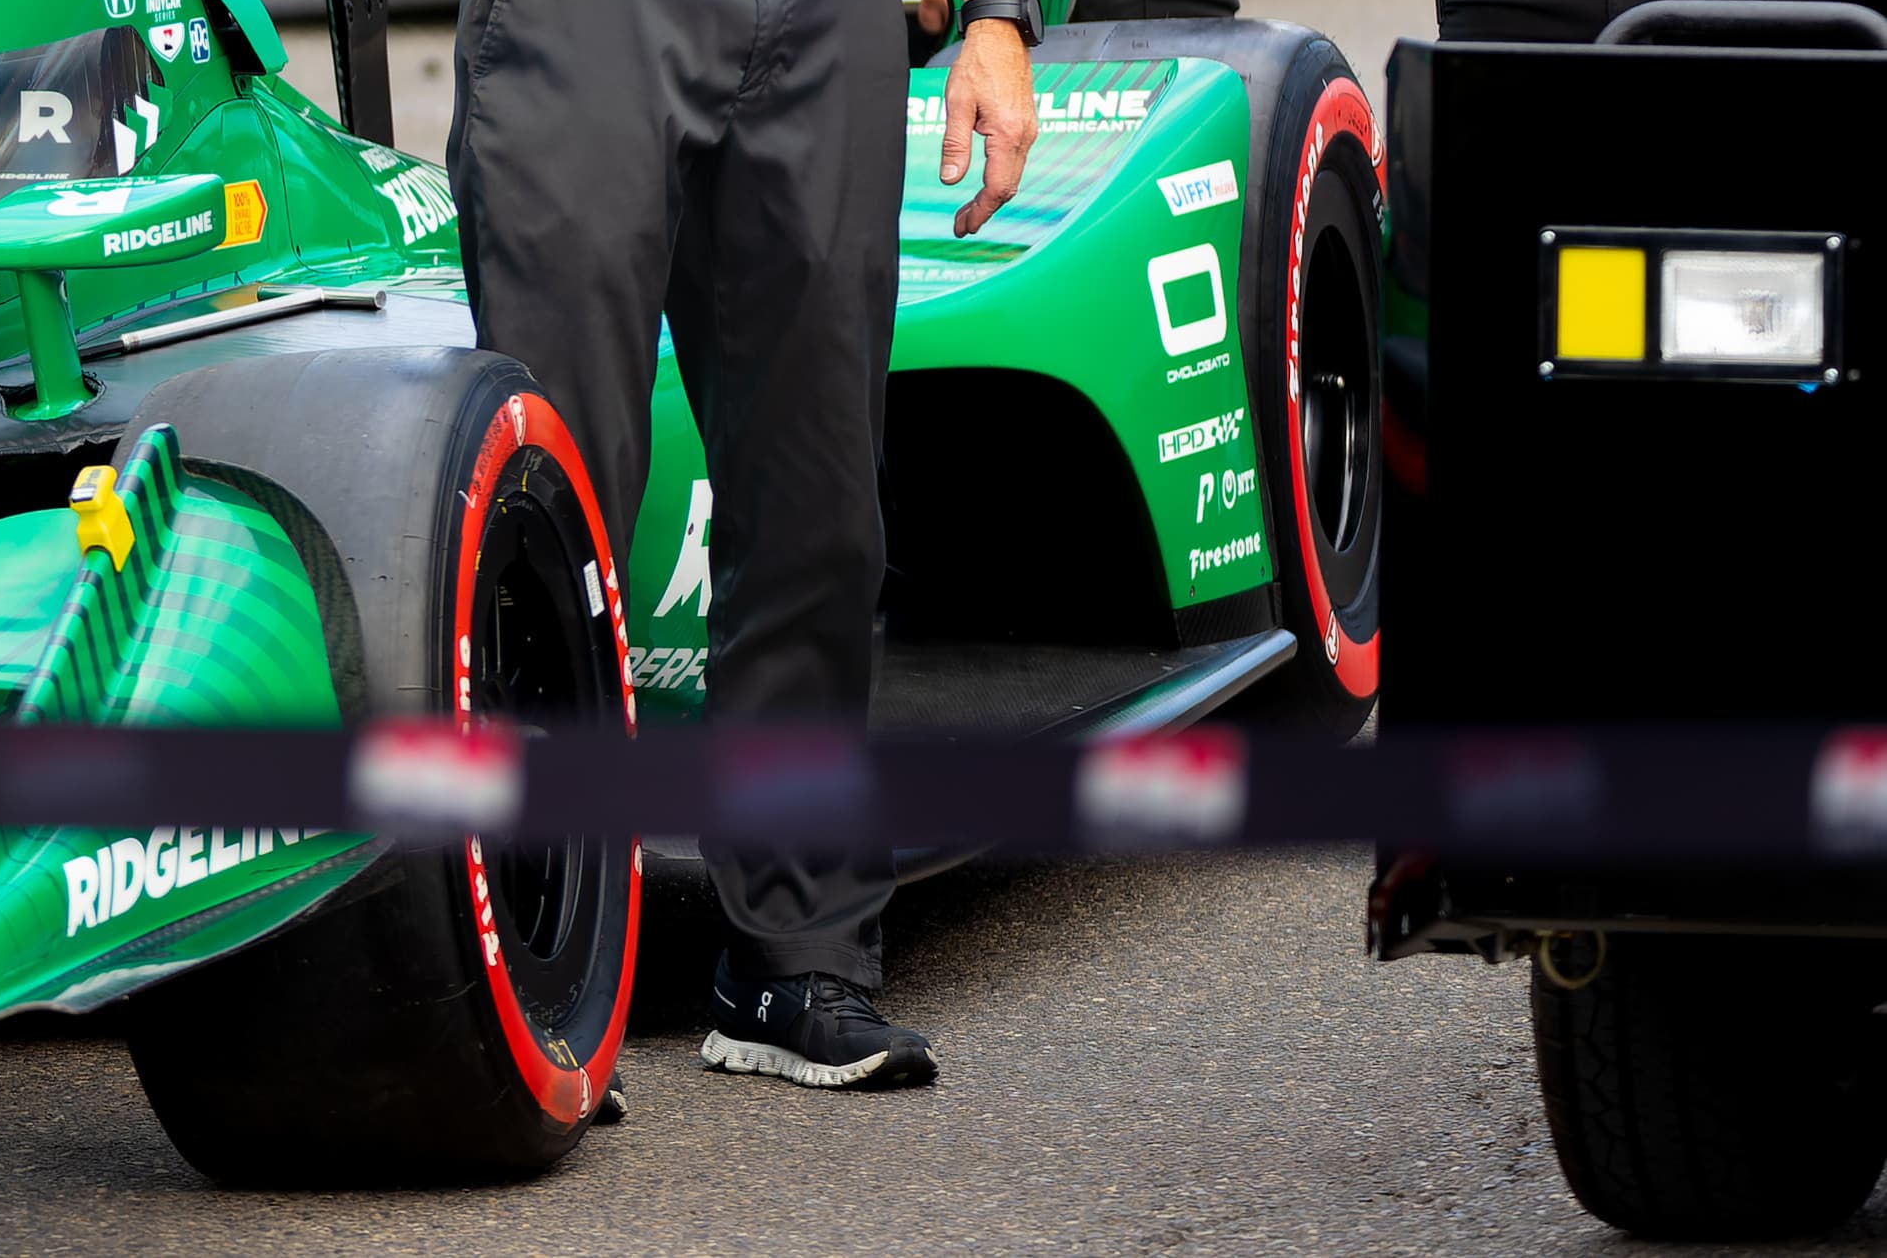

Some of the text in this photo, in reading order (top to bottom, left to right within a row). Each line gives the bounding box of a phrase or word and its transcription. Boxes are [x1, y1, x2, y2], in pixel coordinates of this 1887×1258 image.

[154, 10, 176, 23] SERIES
[1170, 176, 1214, 209] JIFFY
[103, 209, 213, 258] RIDGELINE
[1167, 352, 1231, 384] OMOLOGATO
[1161, 427, 1206, 458] HPD
[1237, 468, 1256, 496] NTT
[1189, 531, 1262, 581] Firestone
